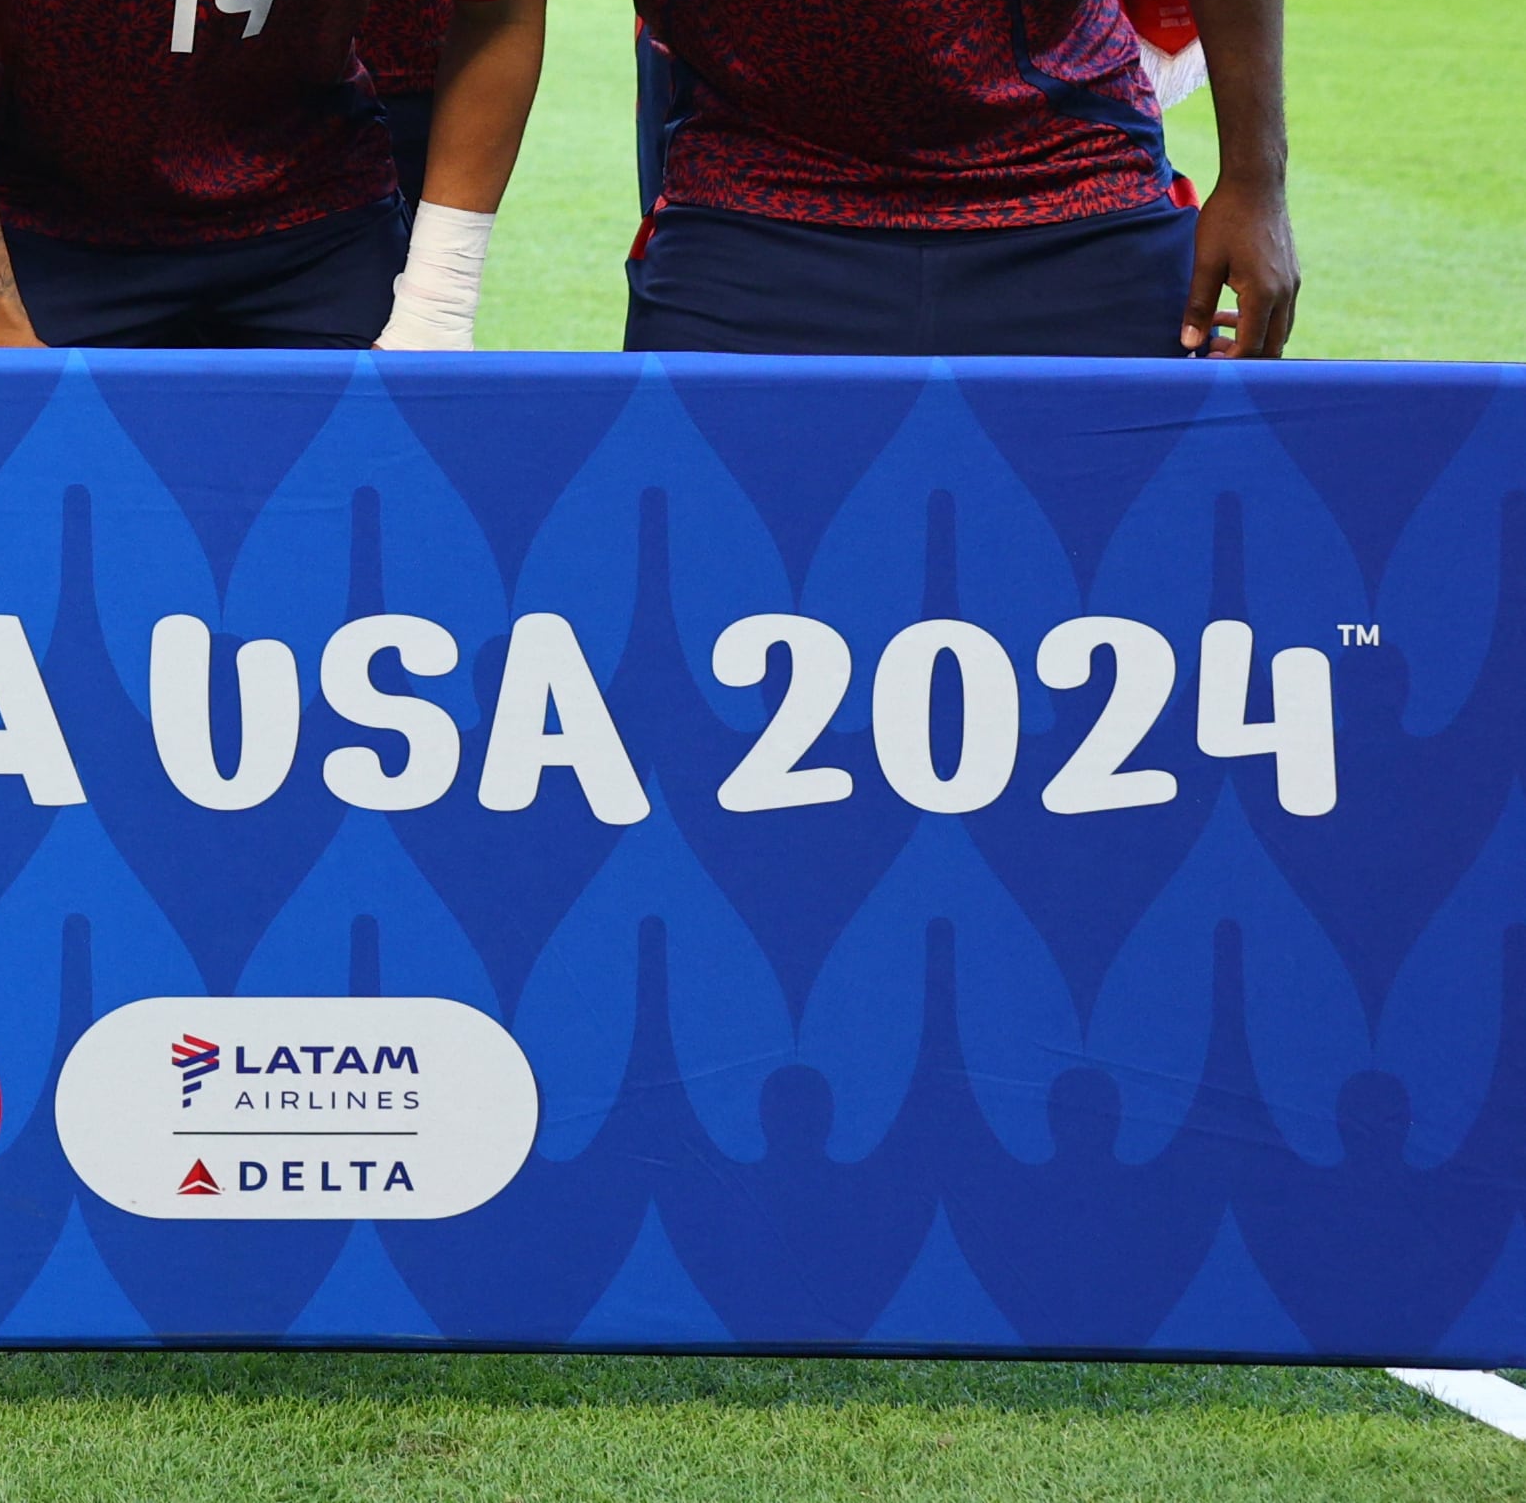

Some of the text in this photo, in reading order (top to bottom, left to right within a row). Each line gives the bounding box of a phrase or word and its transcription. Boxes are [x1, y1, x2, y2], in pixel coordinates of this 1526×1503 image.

[150, 611, 651, 825] USA
[711, 612, 1338, 817] 2024
[235, 1046, 420, 1075] LATAM
[234, 1090, 421, 1111] AIRLINES
[238, 1160, 415, 1192] DELTA
